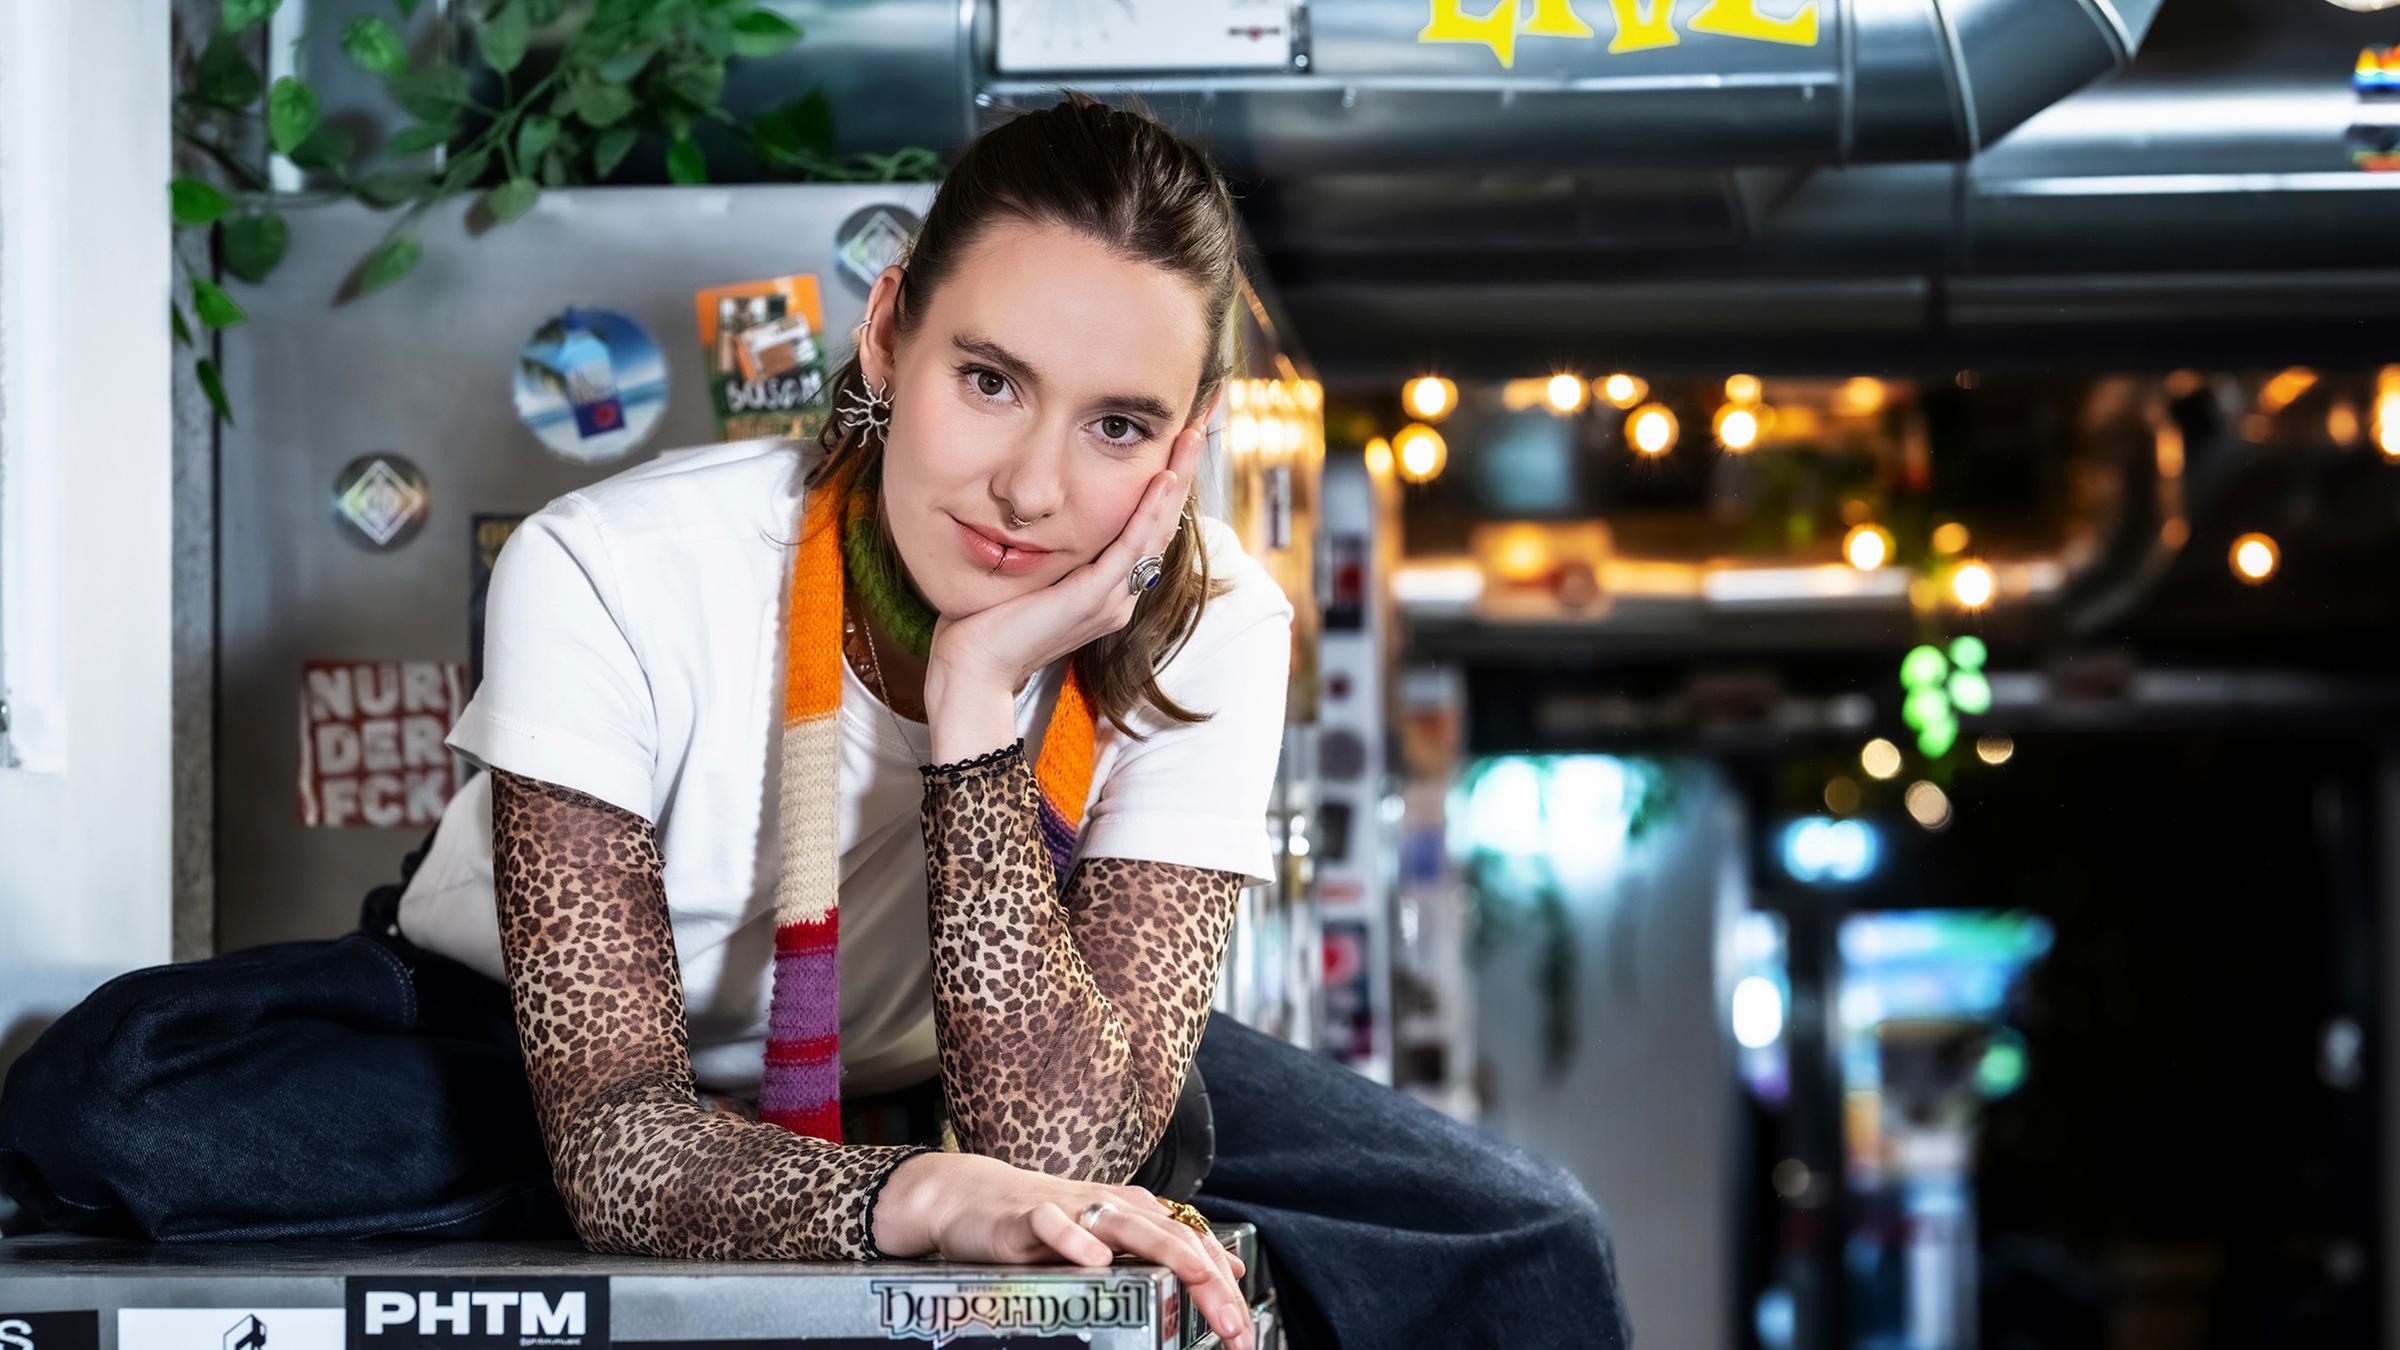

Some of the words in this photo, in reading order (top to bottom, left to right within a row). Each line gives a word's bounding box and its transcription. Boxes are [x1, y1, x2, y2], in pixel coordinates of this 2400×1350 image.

[308, 663, 446, 720] NUR
[316, 714, 449, 775] DER
[322, 768, 449, 828] FCK
[365, 1291, 586, 1335] PHTM
